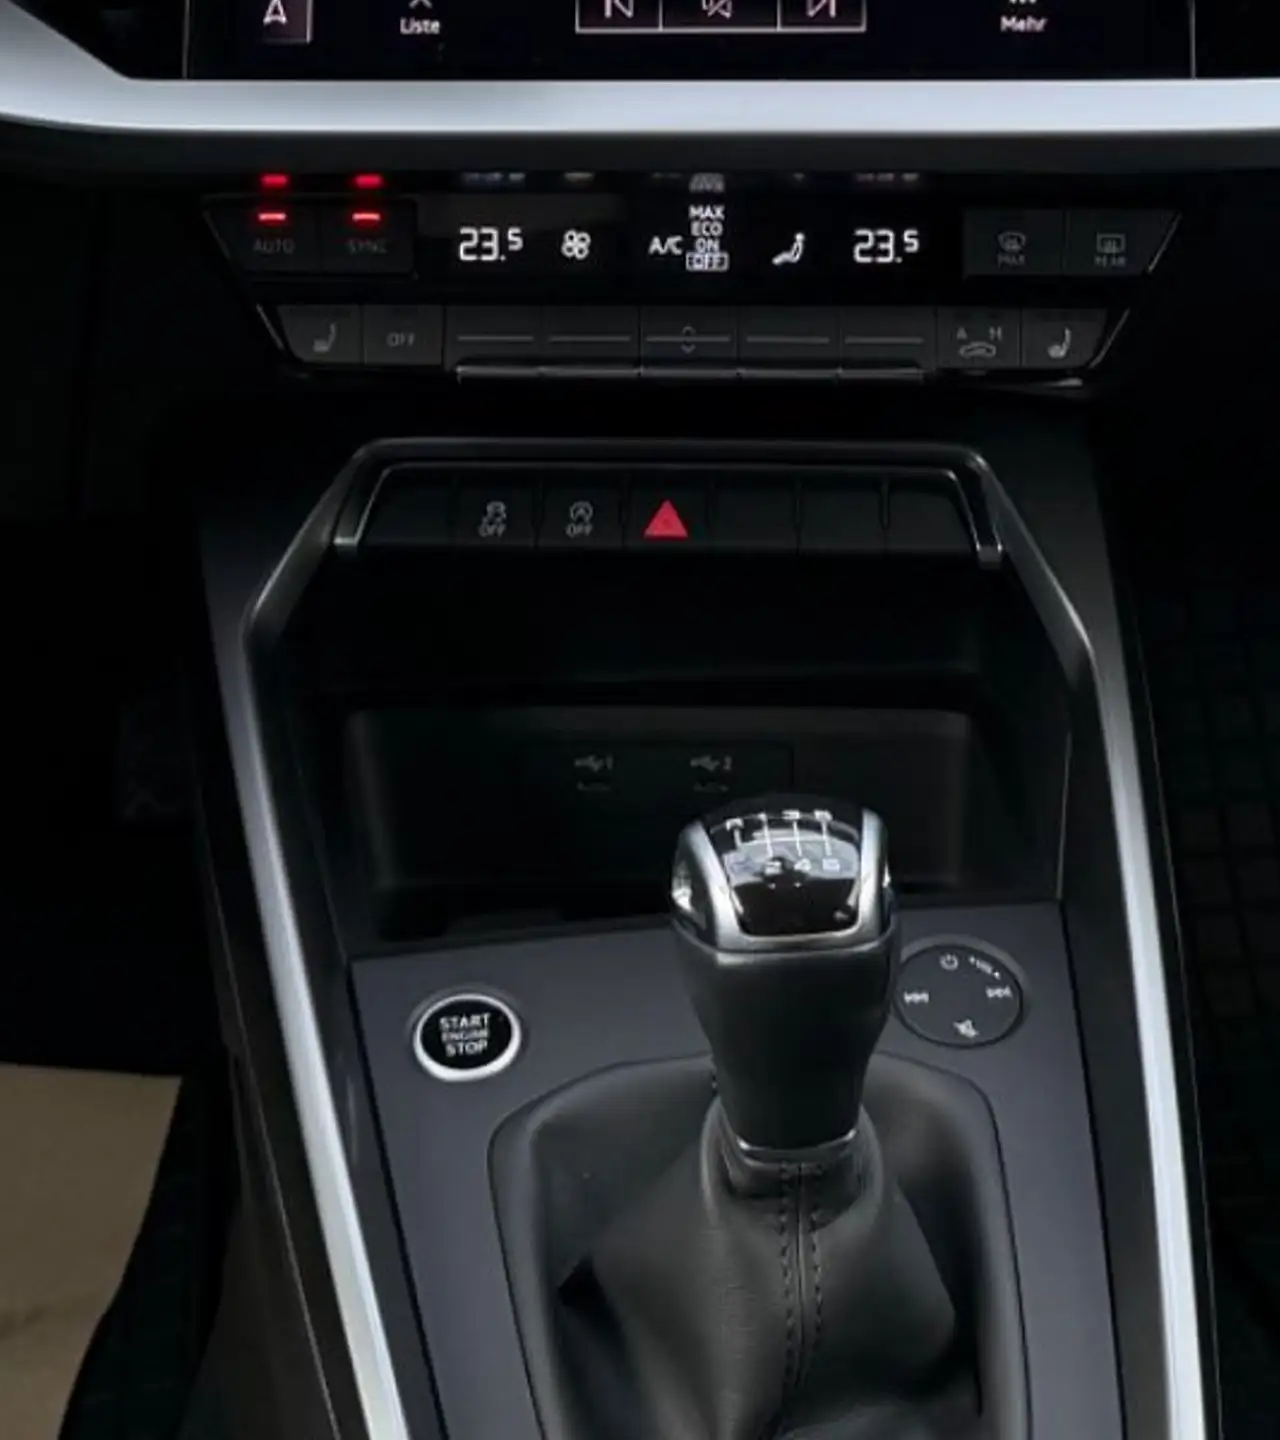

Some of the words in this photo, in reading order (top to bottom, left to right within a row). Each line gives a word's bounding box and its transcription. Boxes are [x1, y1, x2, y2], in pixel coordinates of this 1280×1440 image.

[400, 15, 441, 34] Liste
[1000, 15, 1047, 33] Mehr
[688, 205, 725, 220] MAX
[690, 221, 723, 237] ECO
[459, 227, 523, 261] 23.5
[649, 236, 683, 255] A/C
[853, 229, 919, 263] 23.5
[387, 332, 416, 348] OFF
[440, 1012, 490, 1030] START
[445, 1039, 489, 1058] STOP
